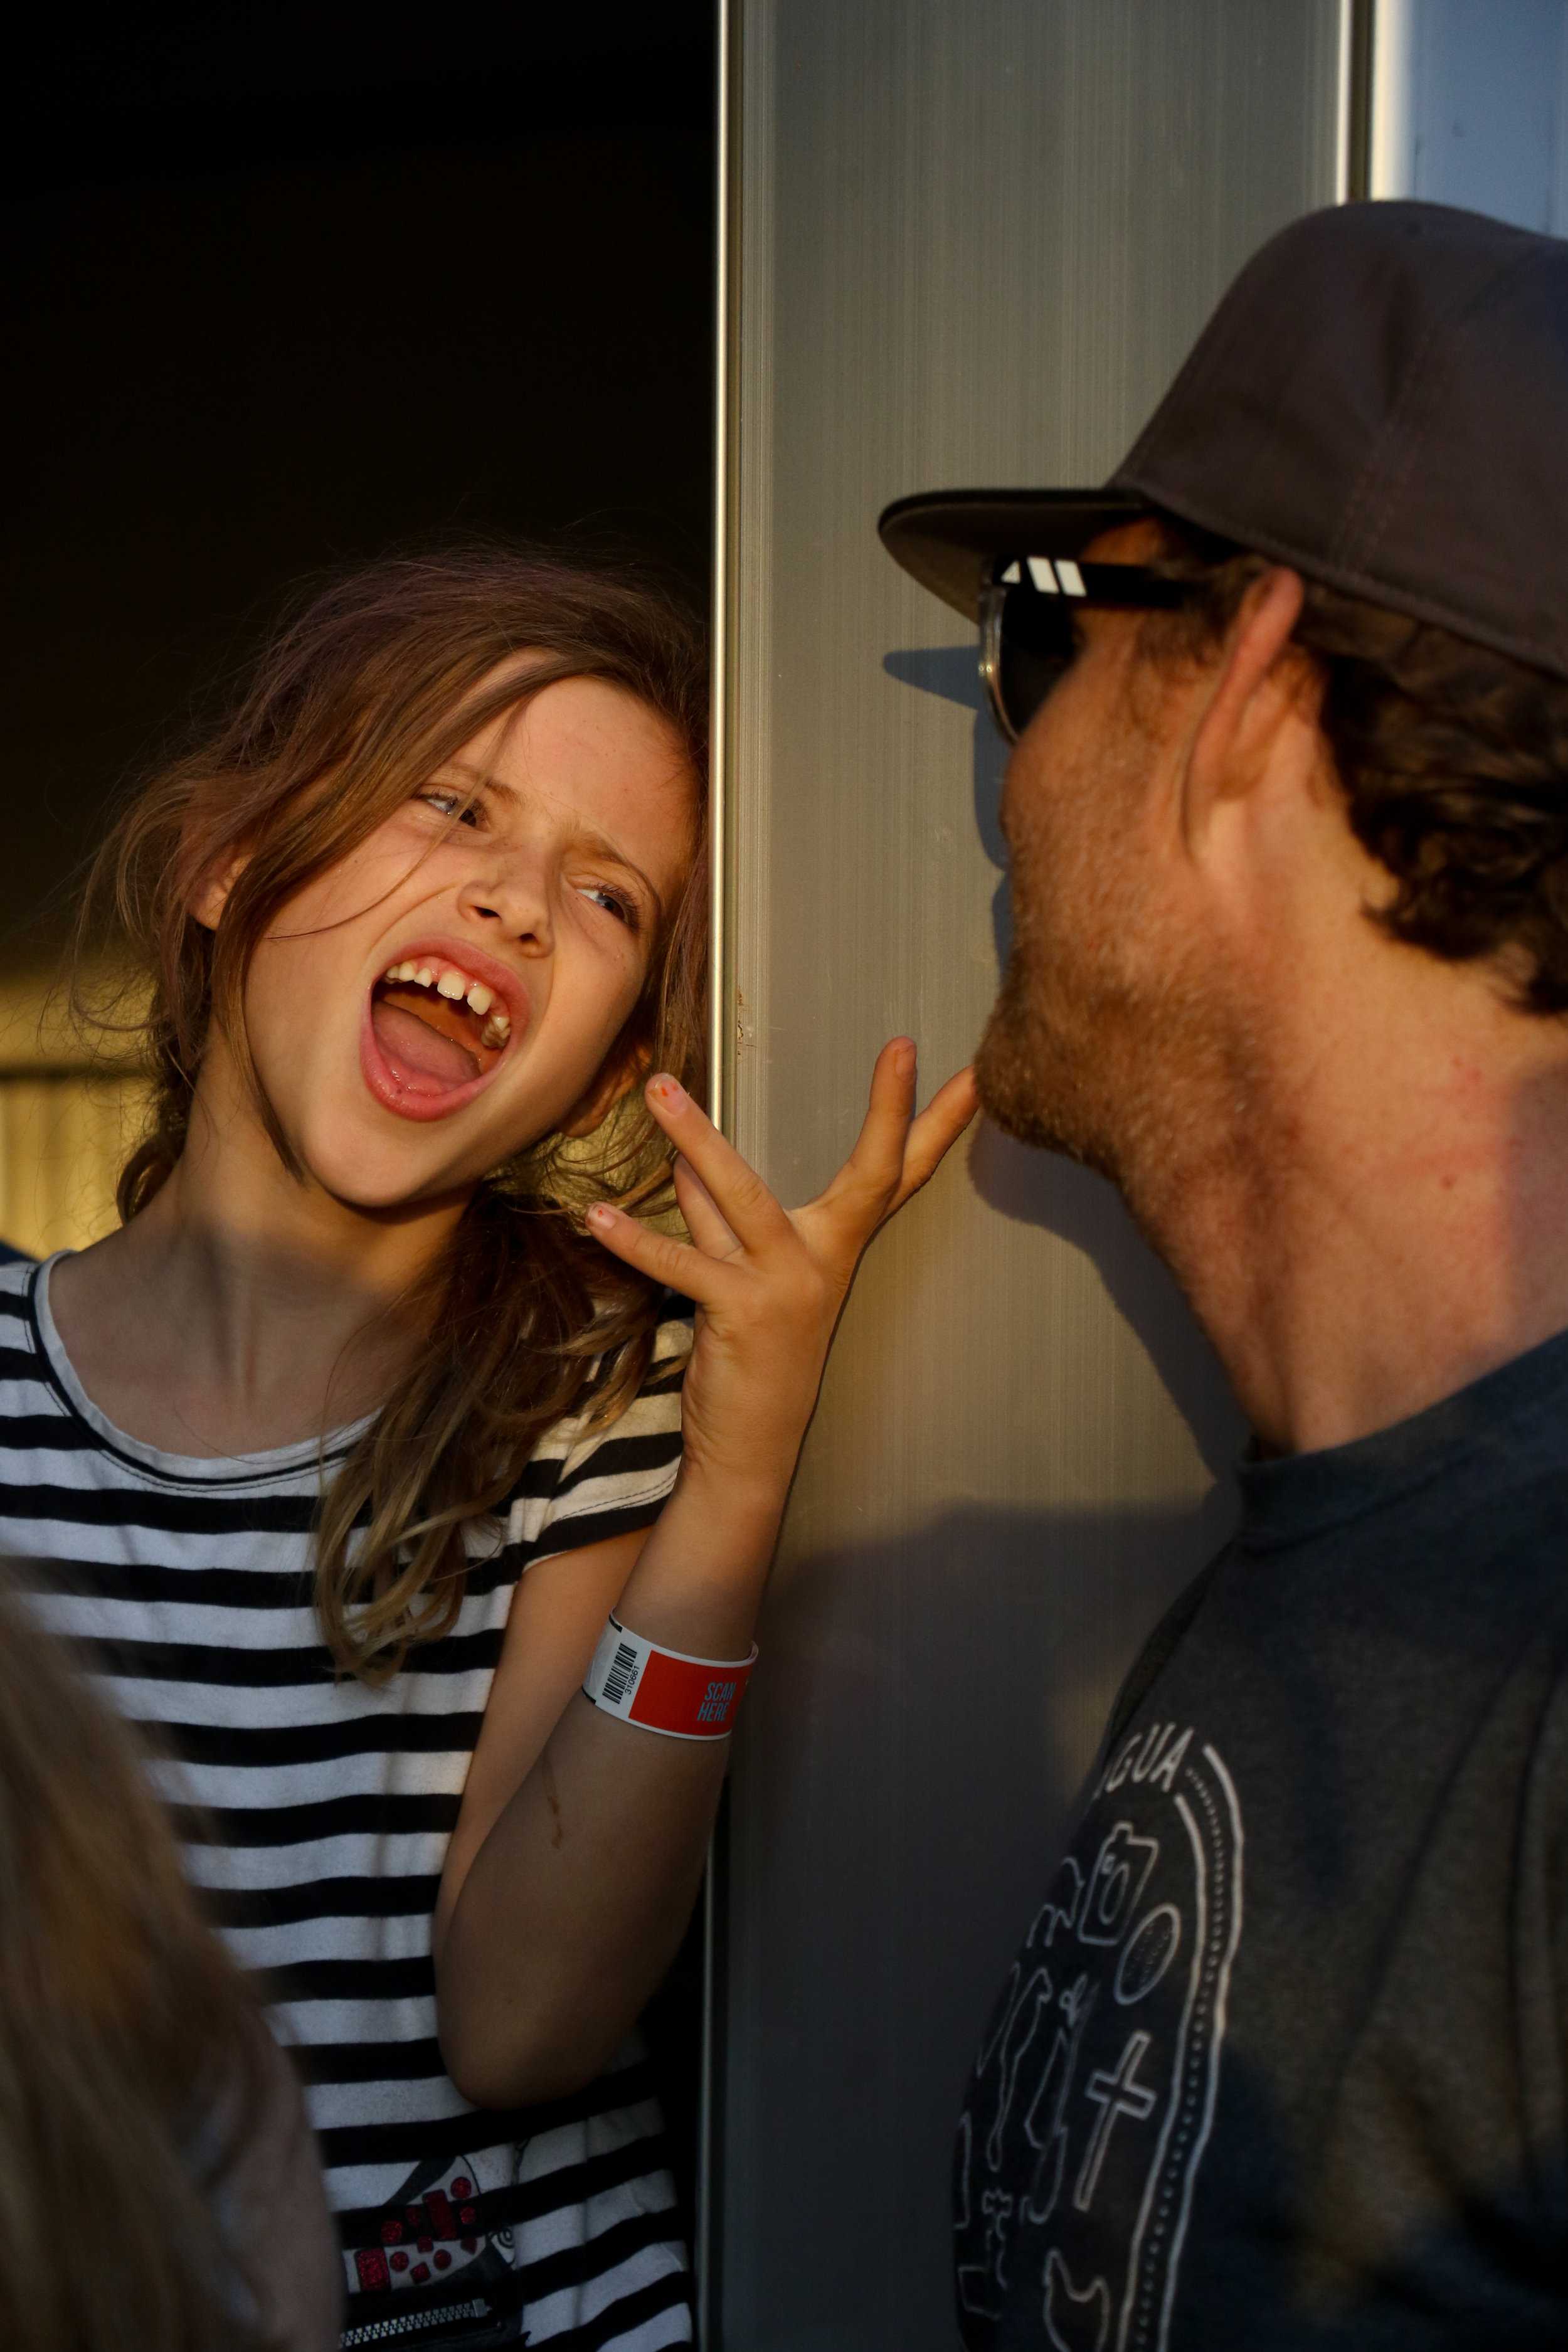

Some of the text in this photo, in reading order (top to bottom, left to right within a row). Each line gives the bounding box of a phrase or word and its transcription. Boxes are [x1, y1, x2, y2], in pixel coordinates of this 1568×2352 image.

[624, 1665, 640, 1695] 310661
[704, 1682, 736, 1701] SCAN
[697, 1702, 729, 1721] HERE
